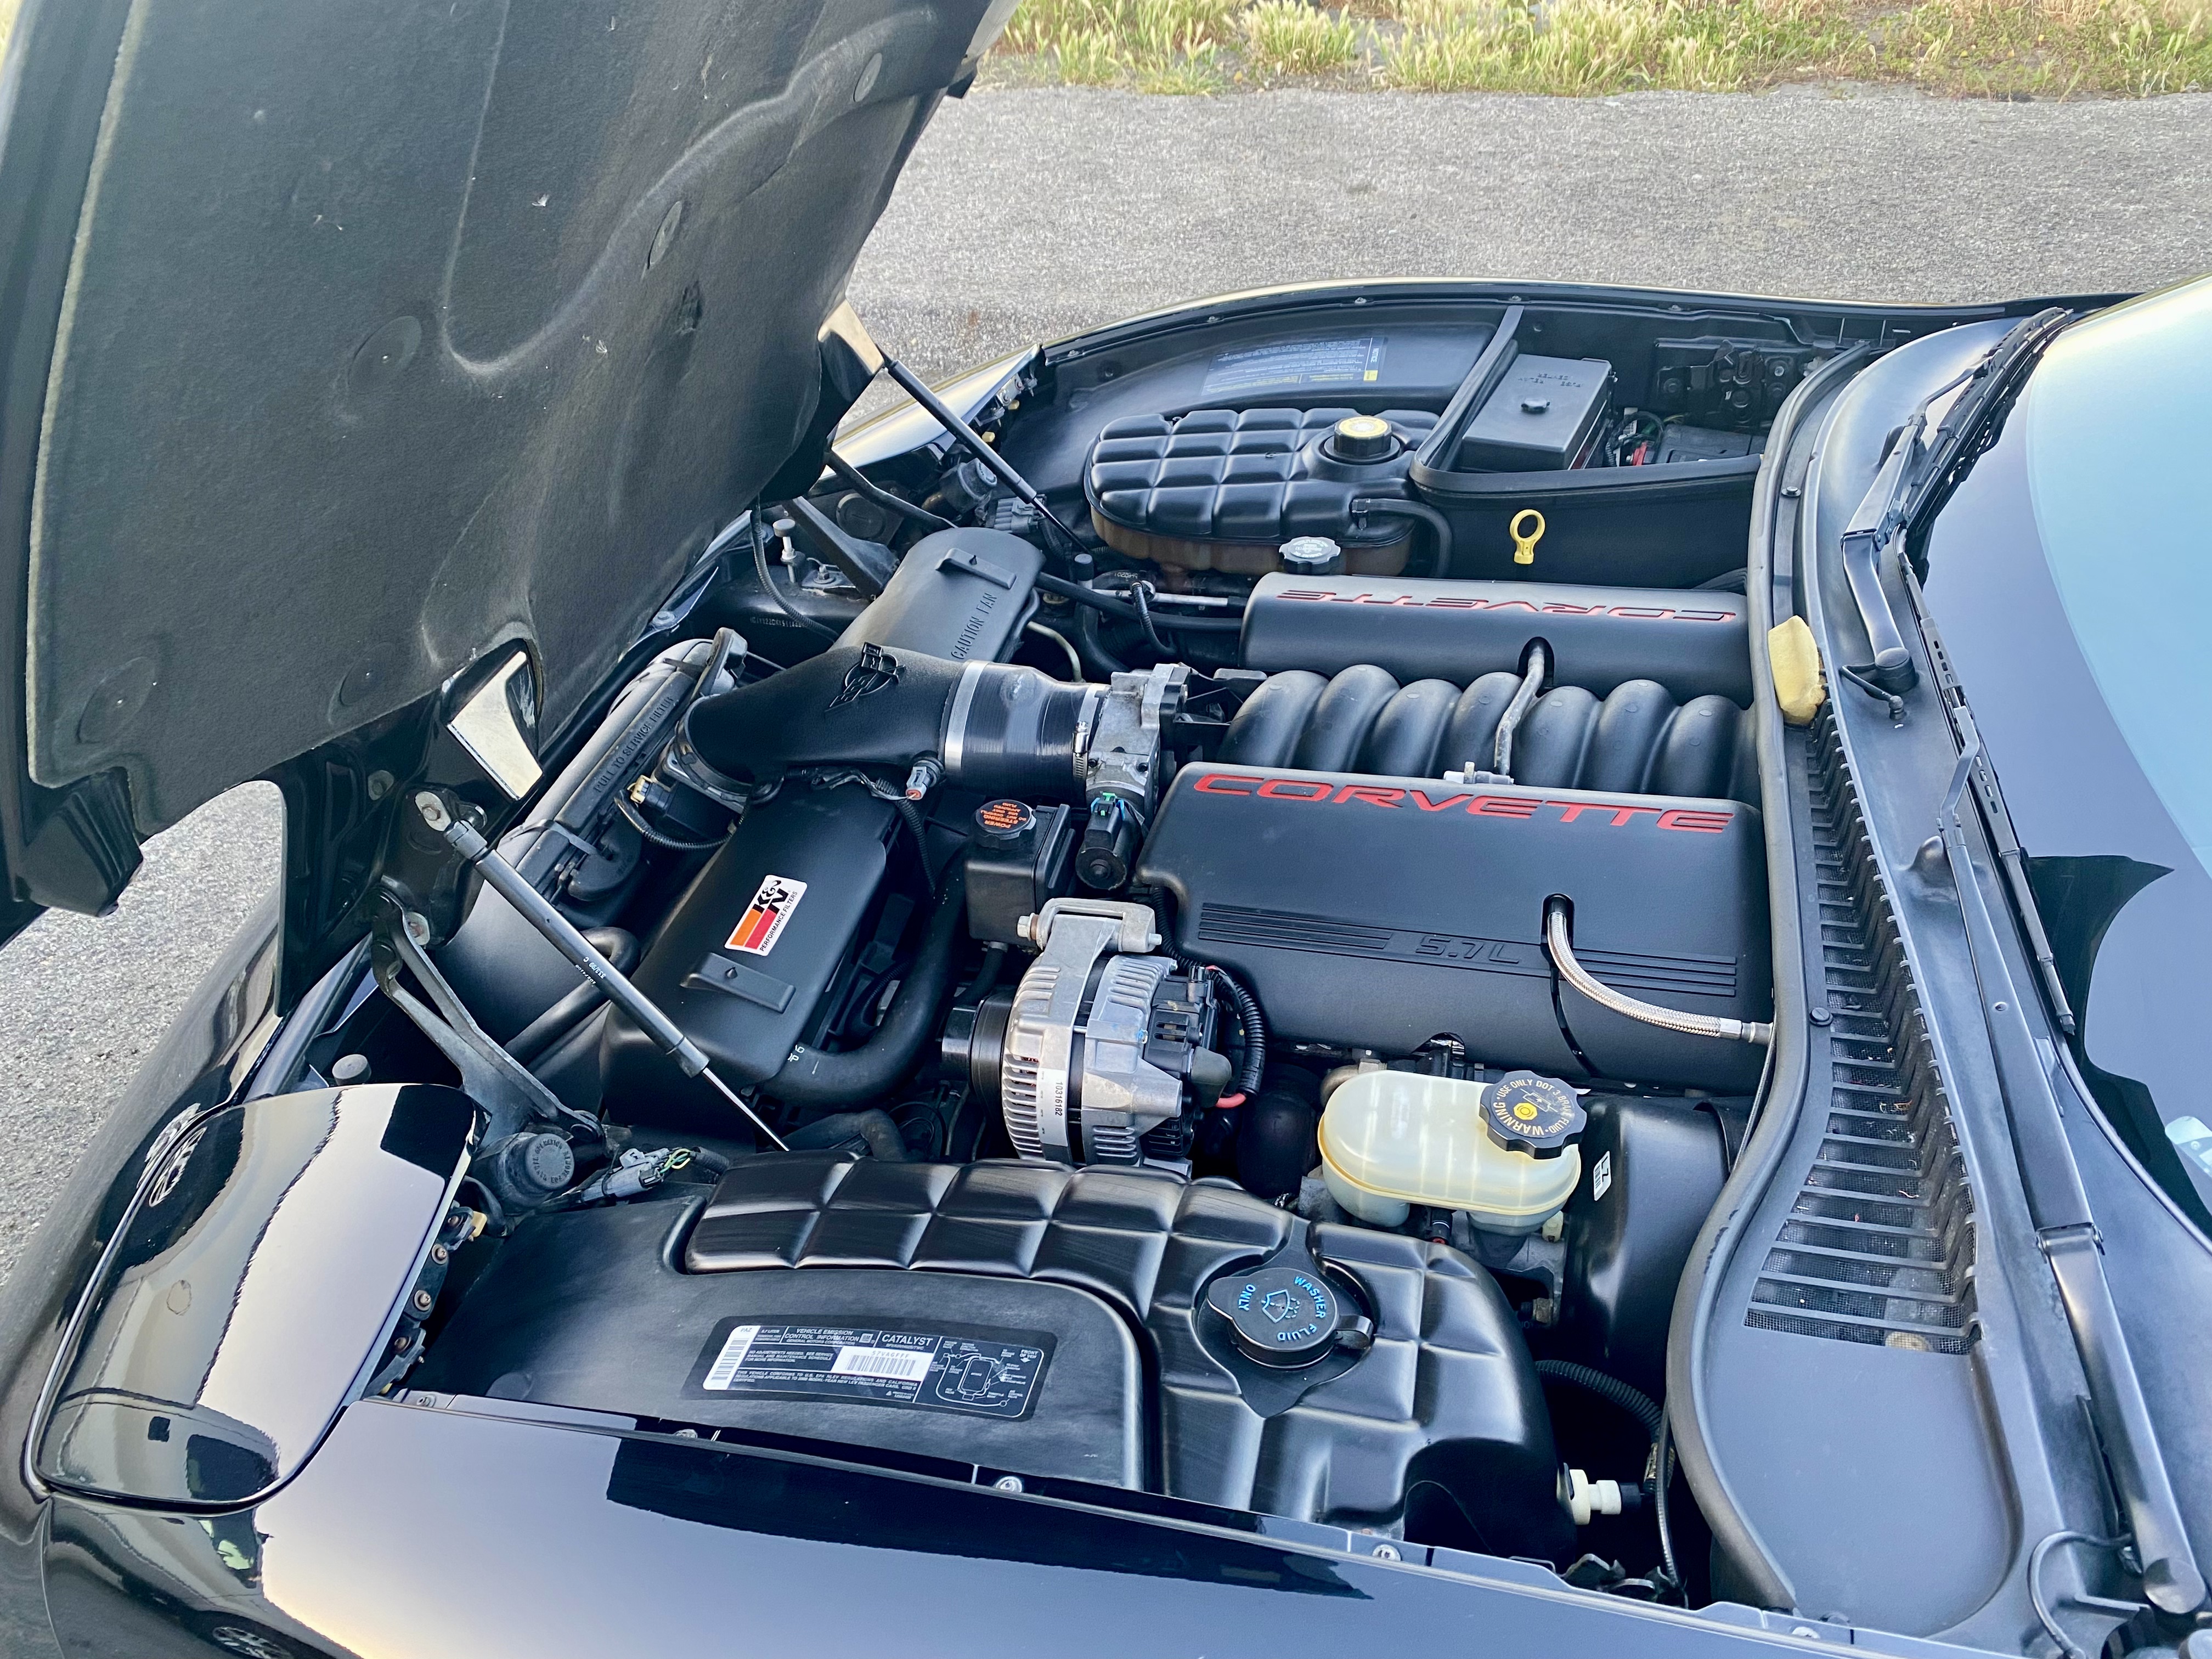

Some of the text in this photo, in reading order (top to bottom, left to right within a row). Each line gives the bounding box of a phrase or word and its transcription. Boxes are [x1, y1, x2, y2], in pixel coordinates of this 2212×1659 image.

[1276, 590, 1737, 622] CORVETTE
[951, 592, 997, 659] CAUTION FAN
[594, 696, 674, 793] PULL TO SERVICE FILTER
[1194, 774, 1734, 833] CORVETTE
[983, 815, 1019, 824] STEERING
[984, 820, 1011, 828] POWER
[760, 891, 798, 951] PERFORMANCE FILTERS
[1415, 935, 1521, 964] 5.7L
[589, 962, 606, 979] 333/99
[1497, 1085, 1512, 1098] USE
[1510, 1079, 1533, 1088] ONLY
[1536, 1080, 1555, 1091] DOT
[1055, 1081, 1063, 1116] 10316182
[1558, 1095, 1575, 1119] BRAKE
[1493, 1102, 1544, 1136] WARNING
[1550, 1117, 1570, 1133] FLUID
[1238, 1276, 1327, 1341] WASHER FLUID ONLY
[882, 1334, 934, 1346] CATALYST
[872, 1350, 910, 1358] 57VAGFFF
